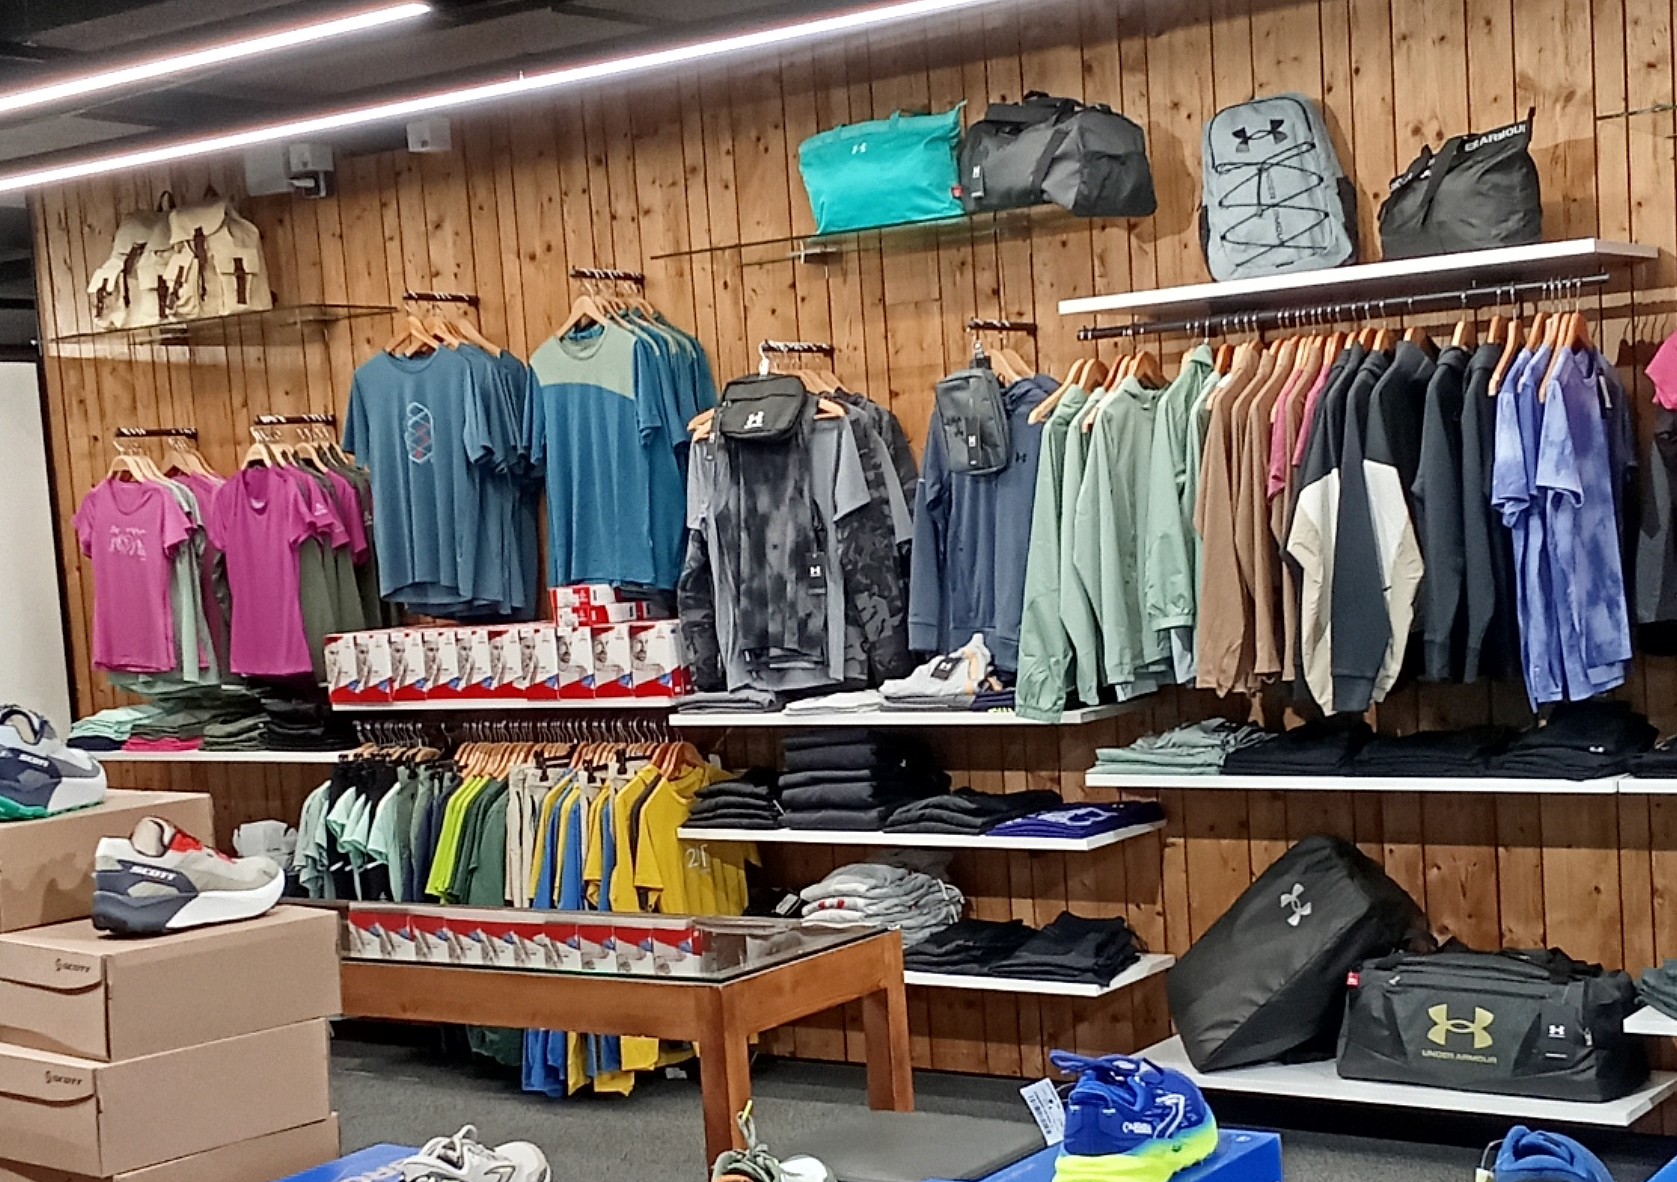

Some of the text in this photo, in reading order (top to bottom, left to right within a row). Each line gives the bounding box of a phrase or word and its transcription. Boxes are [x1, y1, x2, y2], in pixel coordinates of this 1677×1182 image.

[129, 865, 176, 881] SCOTT
[1421, 1049, 1498, 1065] UNDER ARMOUR
